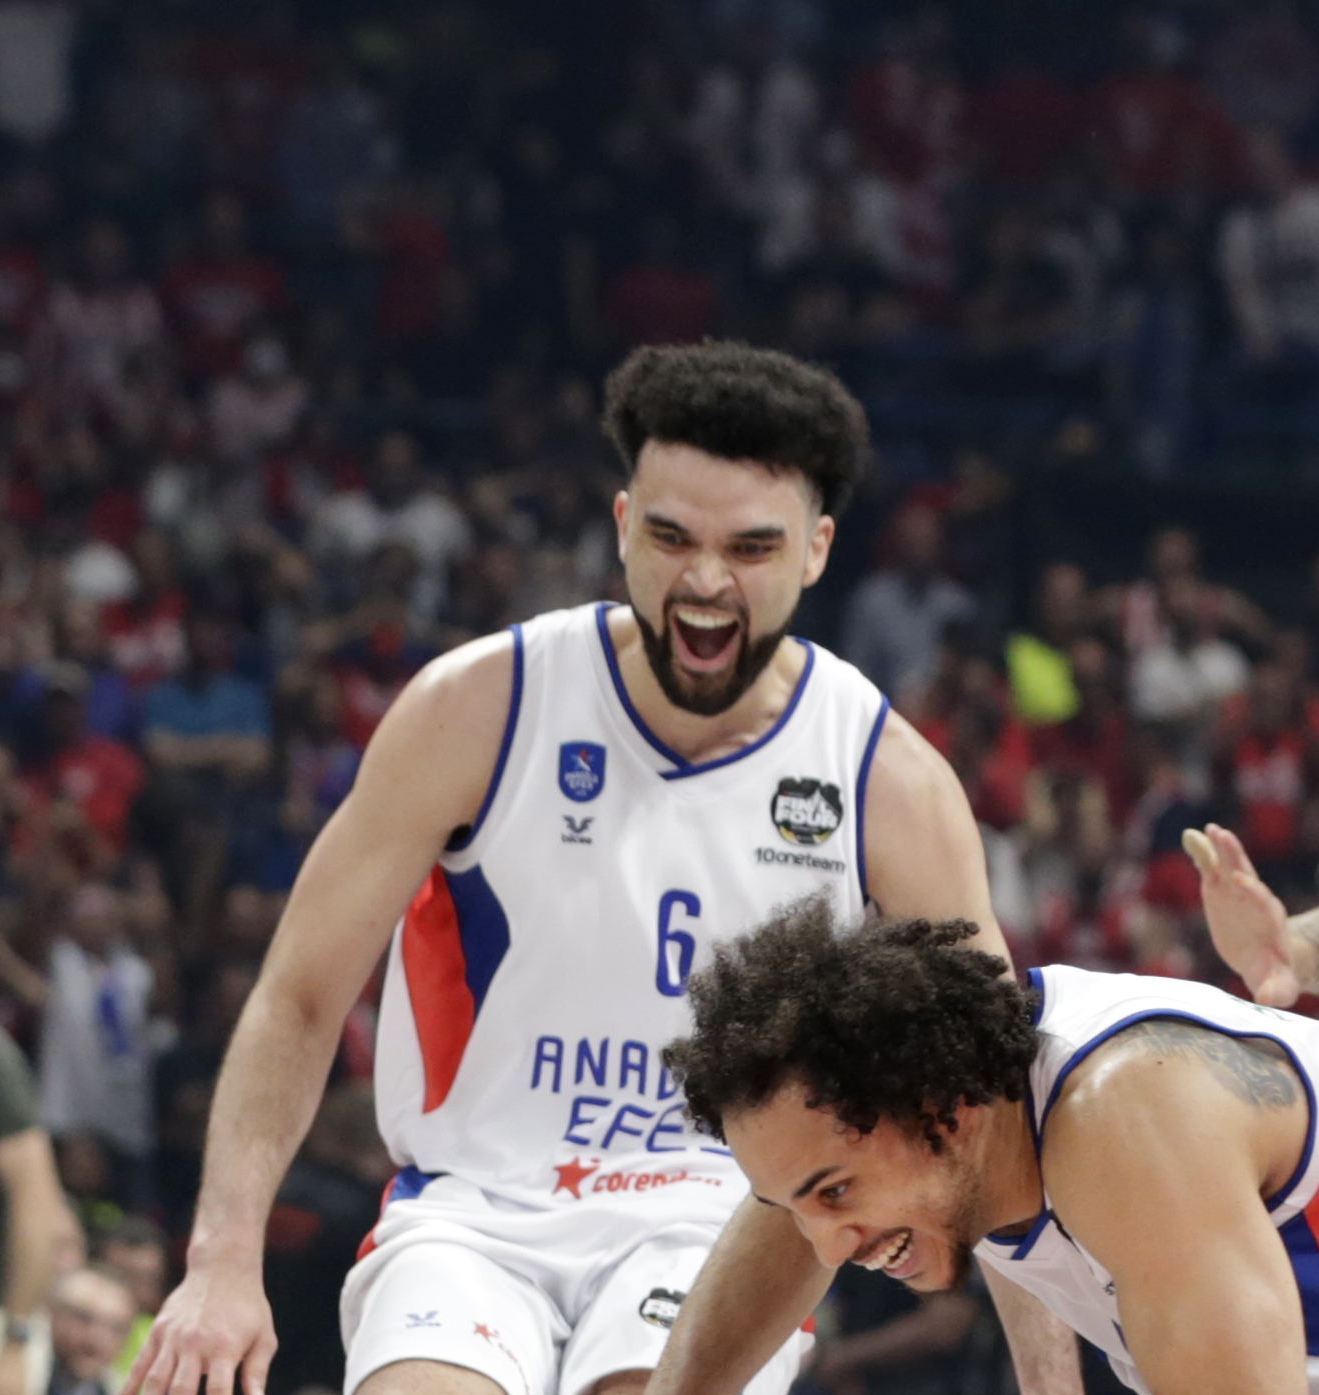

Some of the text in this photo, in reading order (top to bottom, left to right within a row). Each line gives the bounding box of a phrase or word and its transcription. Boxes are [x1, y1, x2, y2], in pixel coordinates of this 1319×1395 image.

[655, 889, 702, 998] 6
[530, 1034, 681, 1101] ANAD
[563, 1095, 736, 1158] EFE
